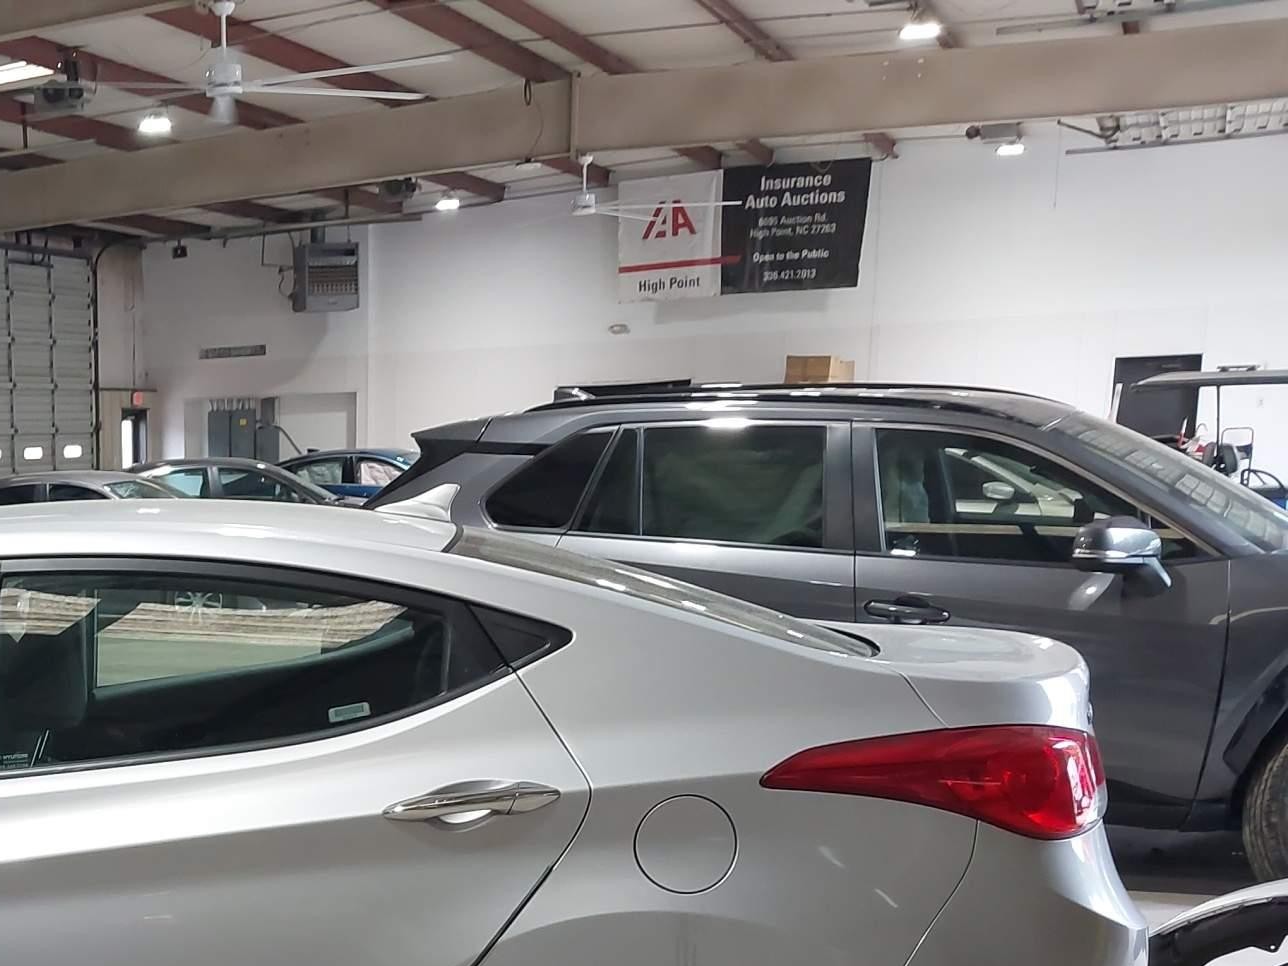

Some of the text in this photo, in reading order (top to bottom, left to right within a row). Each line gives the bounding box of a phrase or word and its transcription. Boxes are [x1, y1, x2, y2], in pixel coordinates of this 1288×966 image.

[760, 174, 832, 191] Insurance
[744, 189, 846, 210] Auto Auctions
[750, 228, 770, 240] High
[795, 225, 809, 235] NC
[753, 248, 830, 263] Open to the Public
[638, 276, 700, 294] High Point
